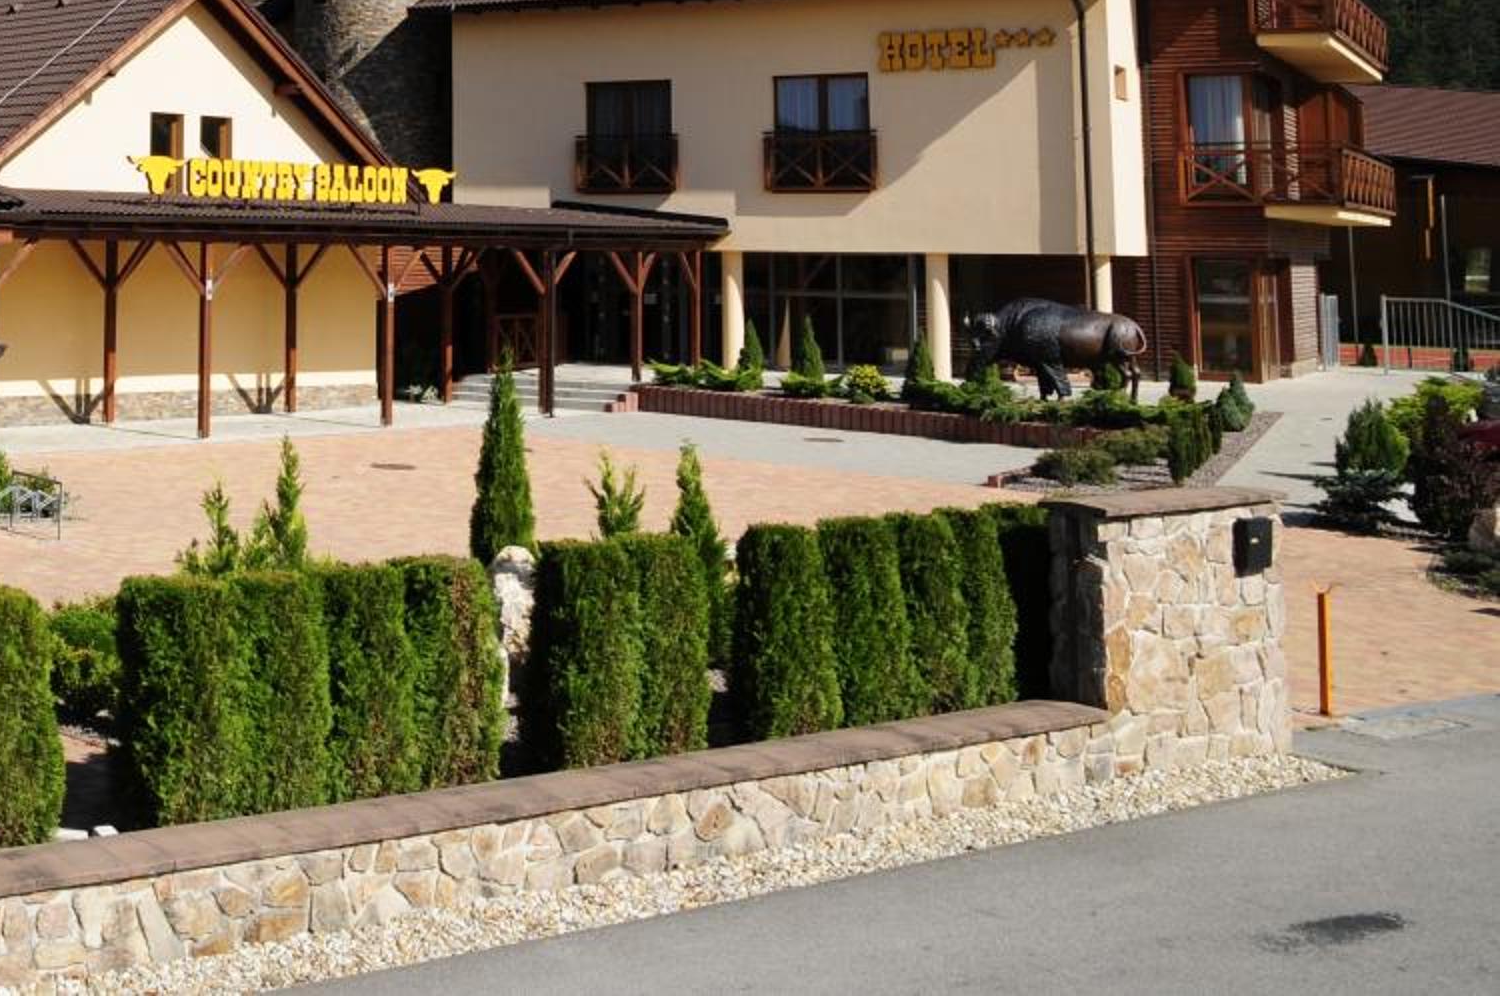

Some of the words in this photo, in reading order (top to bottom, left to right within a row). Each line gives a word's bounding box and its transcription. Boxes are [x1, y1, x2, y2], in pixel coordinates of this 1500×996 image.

[878, 27, 997, 72] HOTEL
[188, 159, 313, 201] COUNTRY
[315, 162, 409, 204] SALOON
